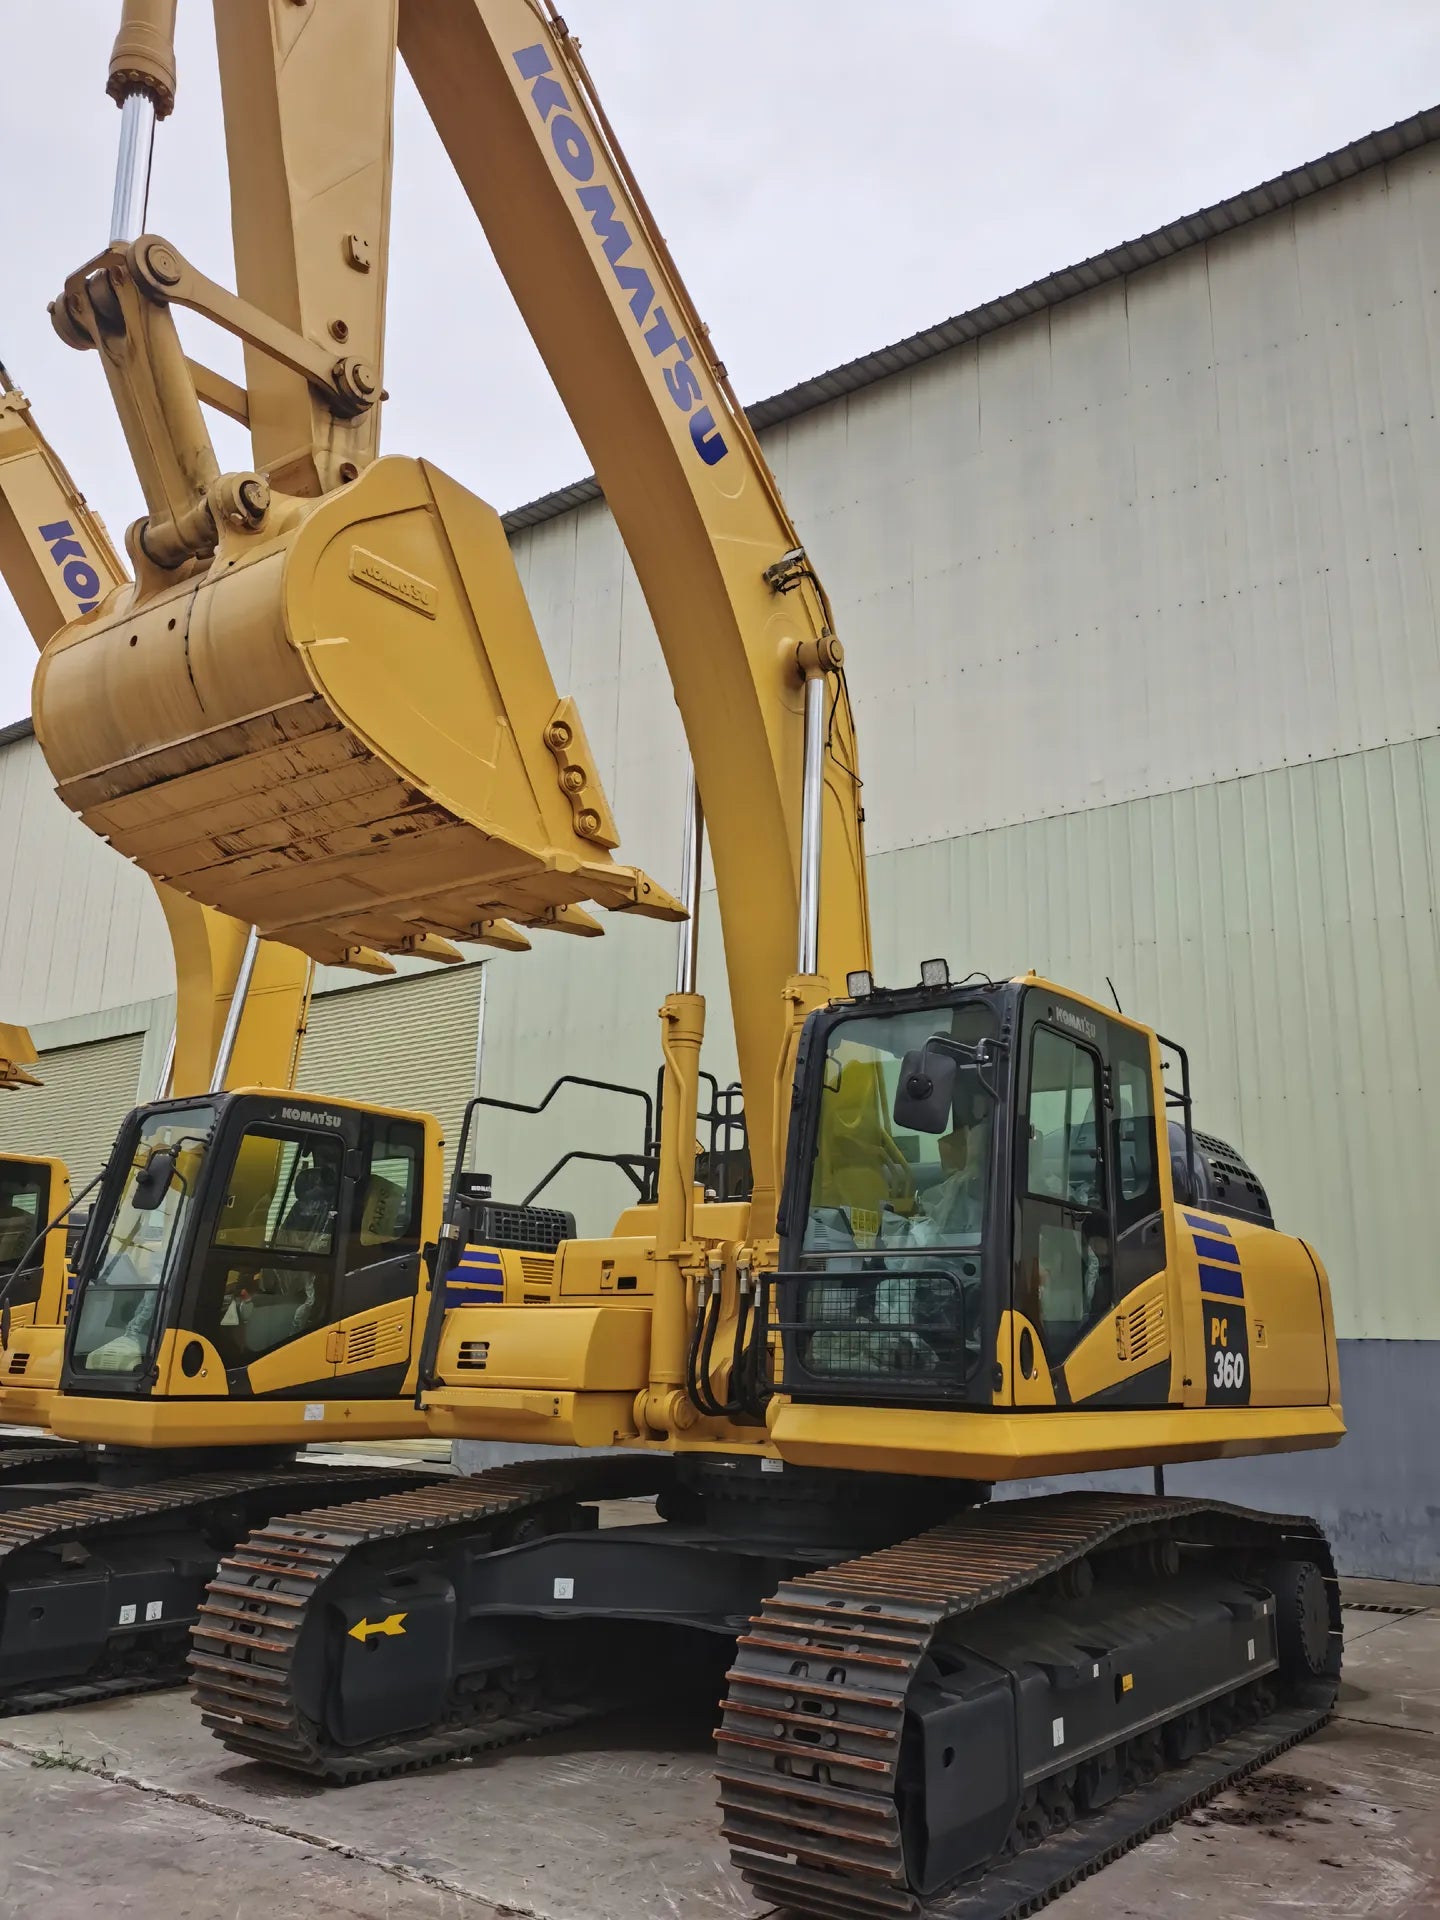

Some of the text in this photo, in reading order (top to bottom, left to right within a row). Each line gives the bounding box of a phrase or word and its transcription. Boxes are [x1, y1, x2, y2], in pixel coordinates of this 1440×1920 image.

[512, 43, 729, 466] KOMATSU
[38, 520, 100, 615] KO
[1055, 1006, 1096, 1039] KOMATSU
[281, 1107, 342, 1128] KOMATSU
[1211, 1317, 1228, 1347] PC
[1213, 1350, 1245, 1389] 360
